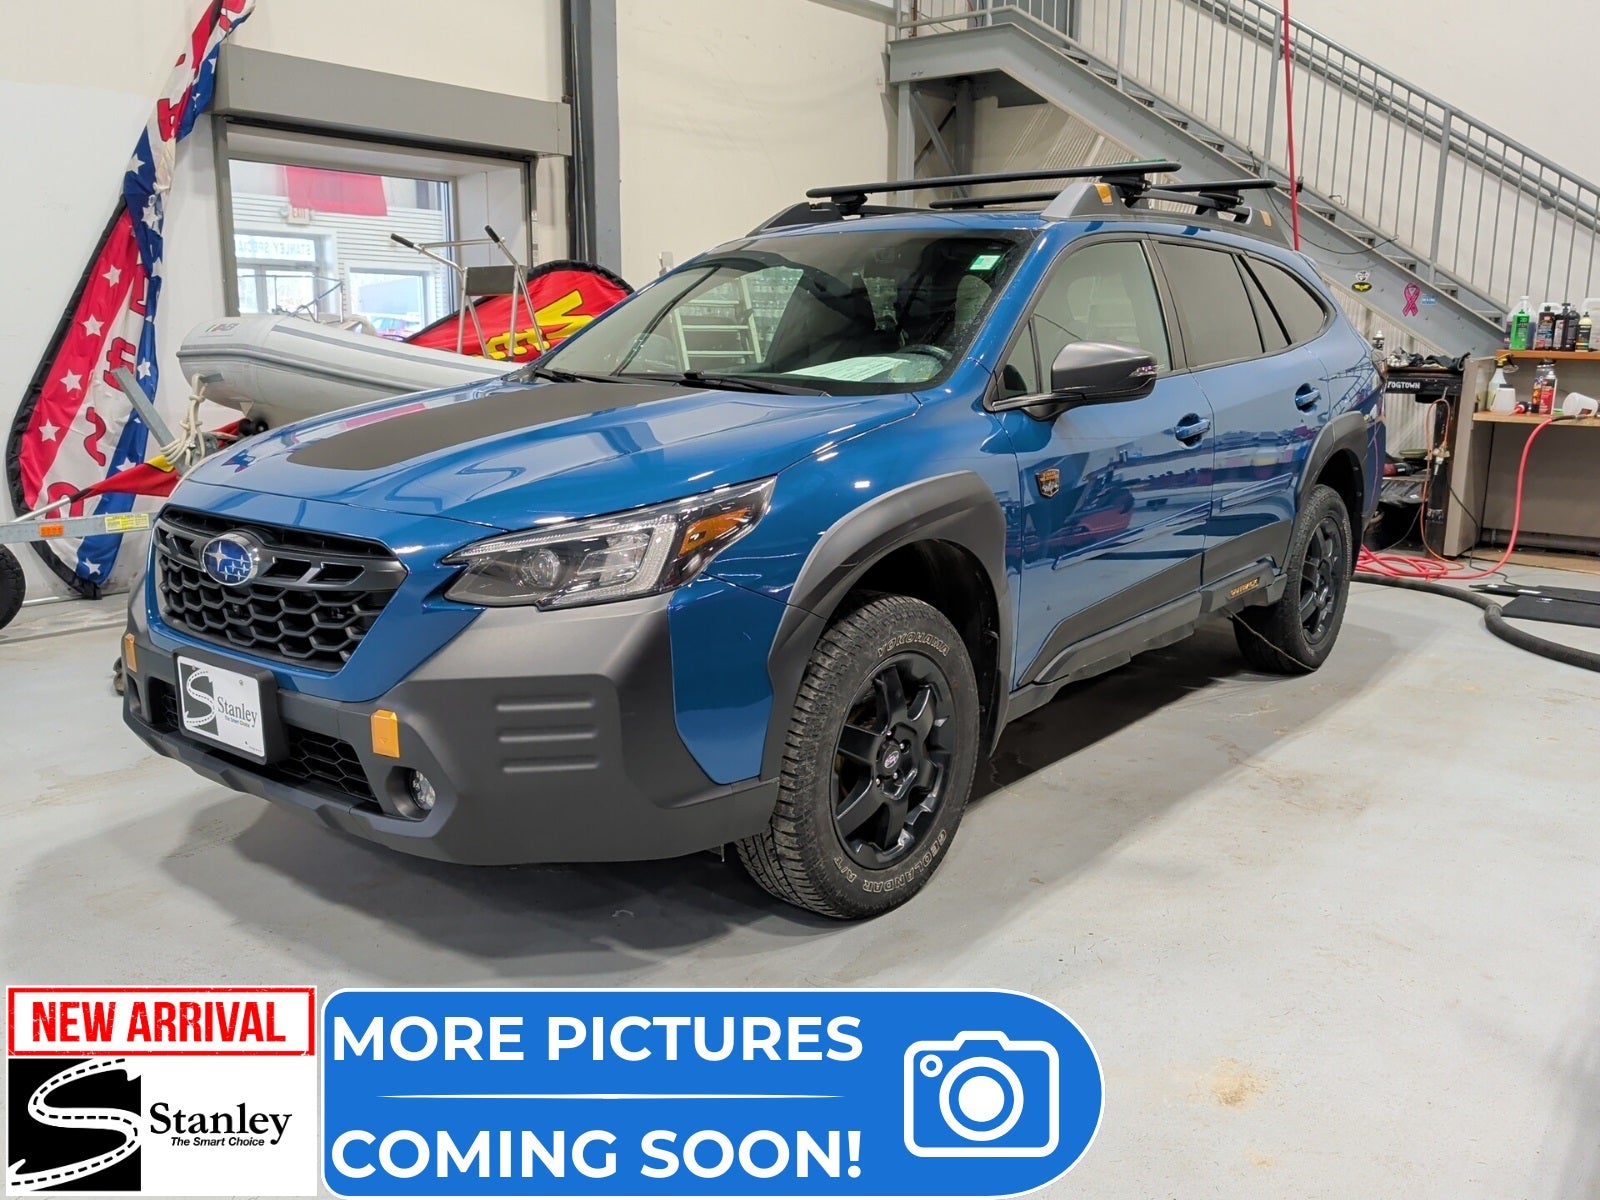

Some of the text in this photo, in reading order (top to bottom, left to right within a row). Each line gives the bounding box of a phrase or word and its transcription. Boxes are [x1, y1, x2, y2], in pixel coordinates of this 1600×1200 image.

[877, 631, 950, 658] YOKOHAMA
[217, 696, 258, 728] Stanley
[834, 829, 947, 894] GEOLANDAR A/T
